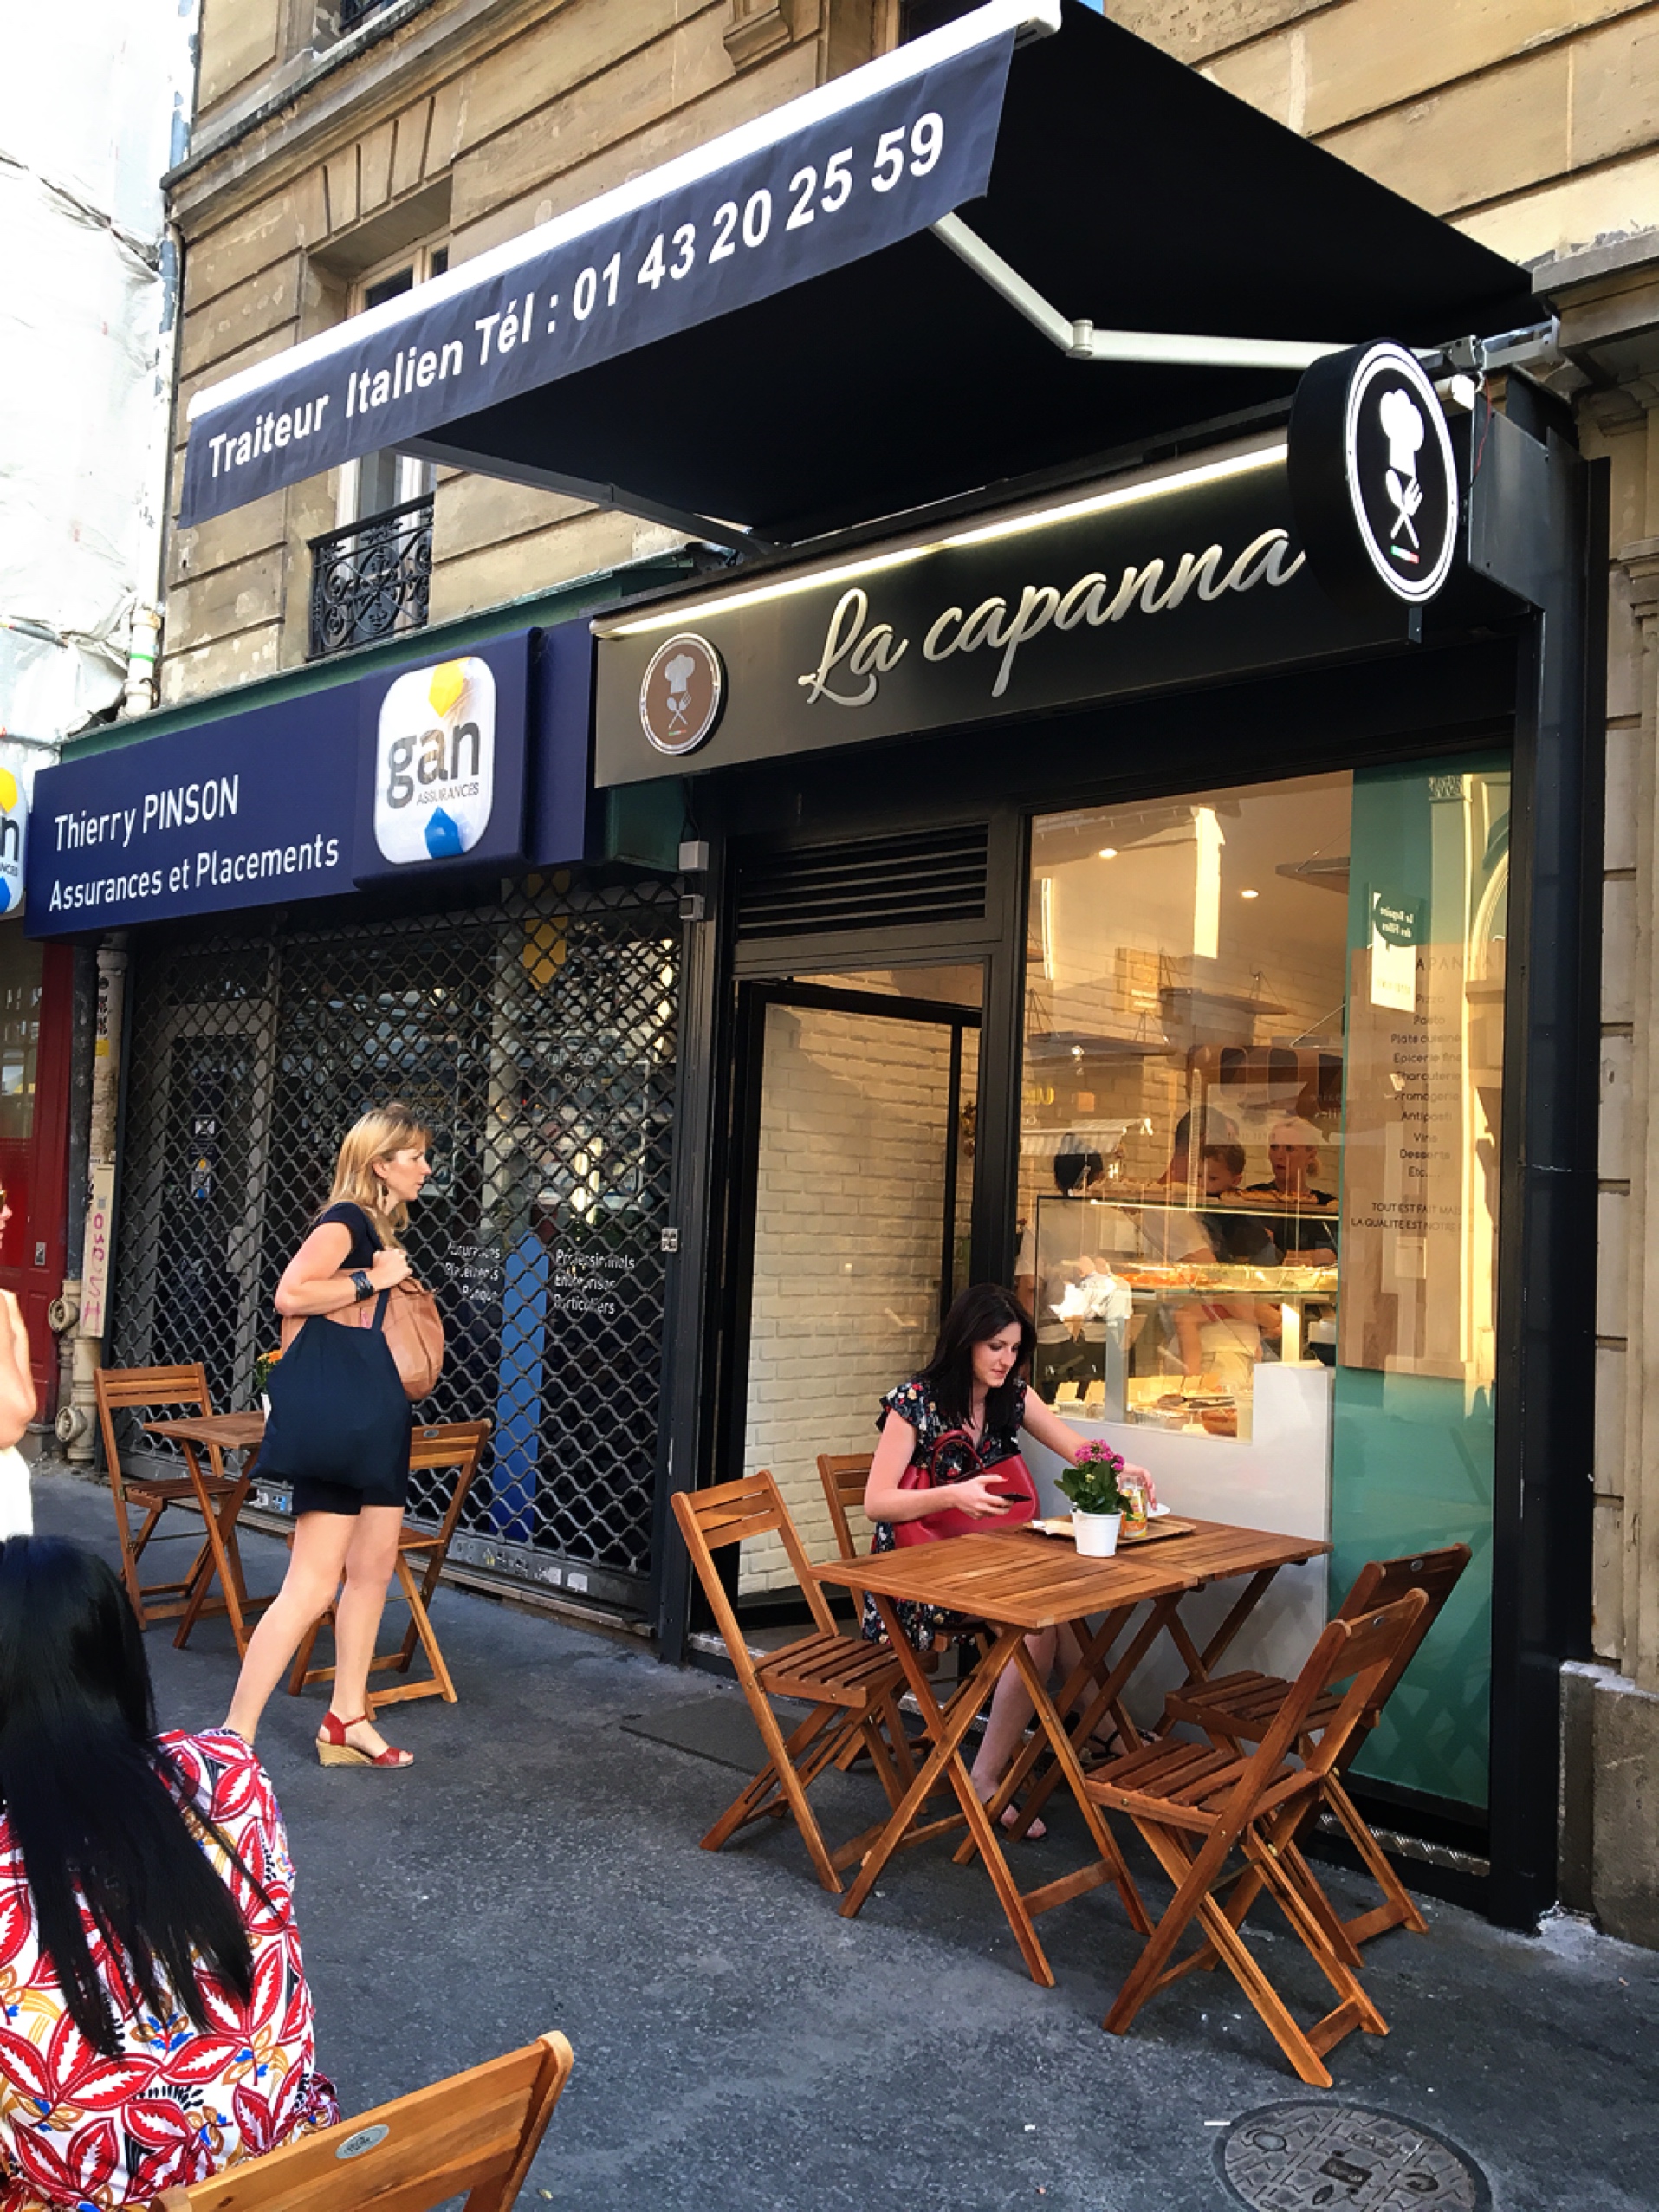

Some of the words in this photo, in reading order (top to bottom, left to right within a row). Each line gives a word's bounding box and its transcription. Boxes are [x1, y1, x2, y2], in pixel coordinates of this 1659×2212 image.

[209, 393, 330, 477] Traiteur
[345, 339, 463, 418] Italien
[475, 294, 534, 366] Tél
[573, 254, 621, 321] 01
[637, 223, 696, 289] 43
[708, 189, 772, 263] 20
[785, 146, 853, 230] 25
[871, 111, 945, 192] 59
[797, 587, 908, 707] La
[921, 528, 1306, 697] capanna
[386, 722, 480, 809] gan
[416, 782, 480, 806] ASSURANCES
[55, 808, 136, 852] Thierry
[142, 774, 239, 834] PINSON
[49, 870, 162, 912] Assurances
[169, 858, 190, 892] et
[195, 834, 339, 889] Placements
[1351, 1216, 1364, 1227] LA
[1405, 1219, 1424, 1230] EST
[1371, 1202, 1397, 1212] TOUT
[1398, 1203, 1416, 1213] EST
